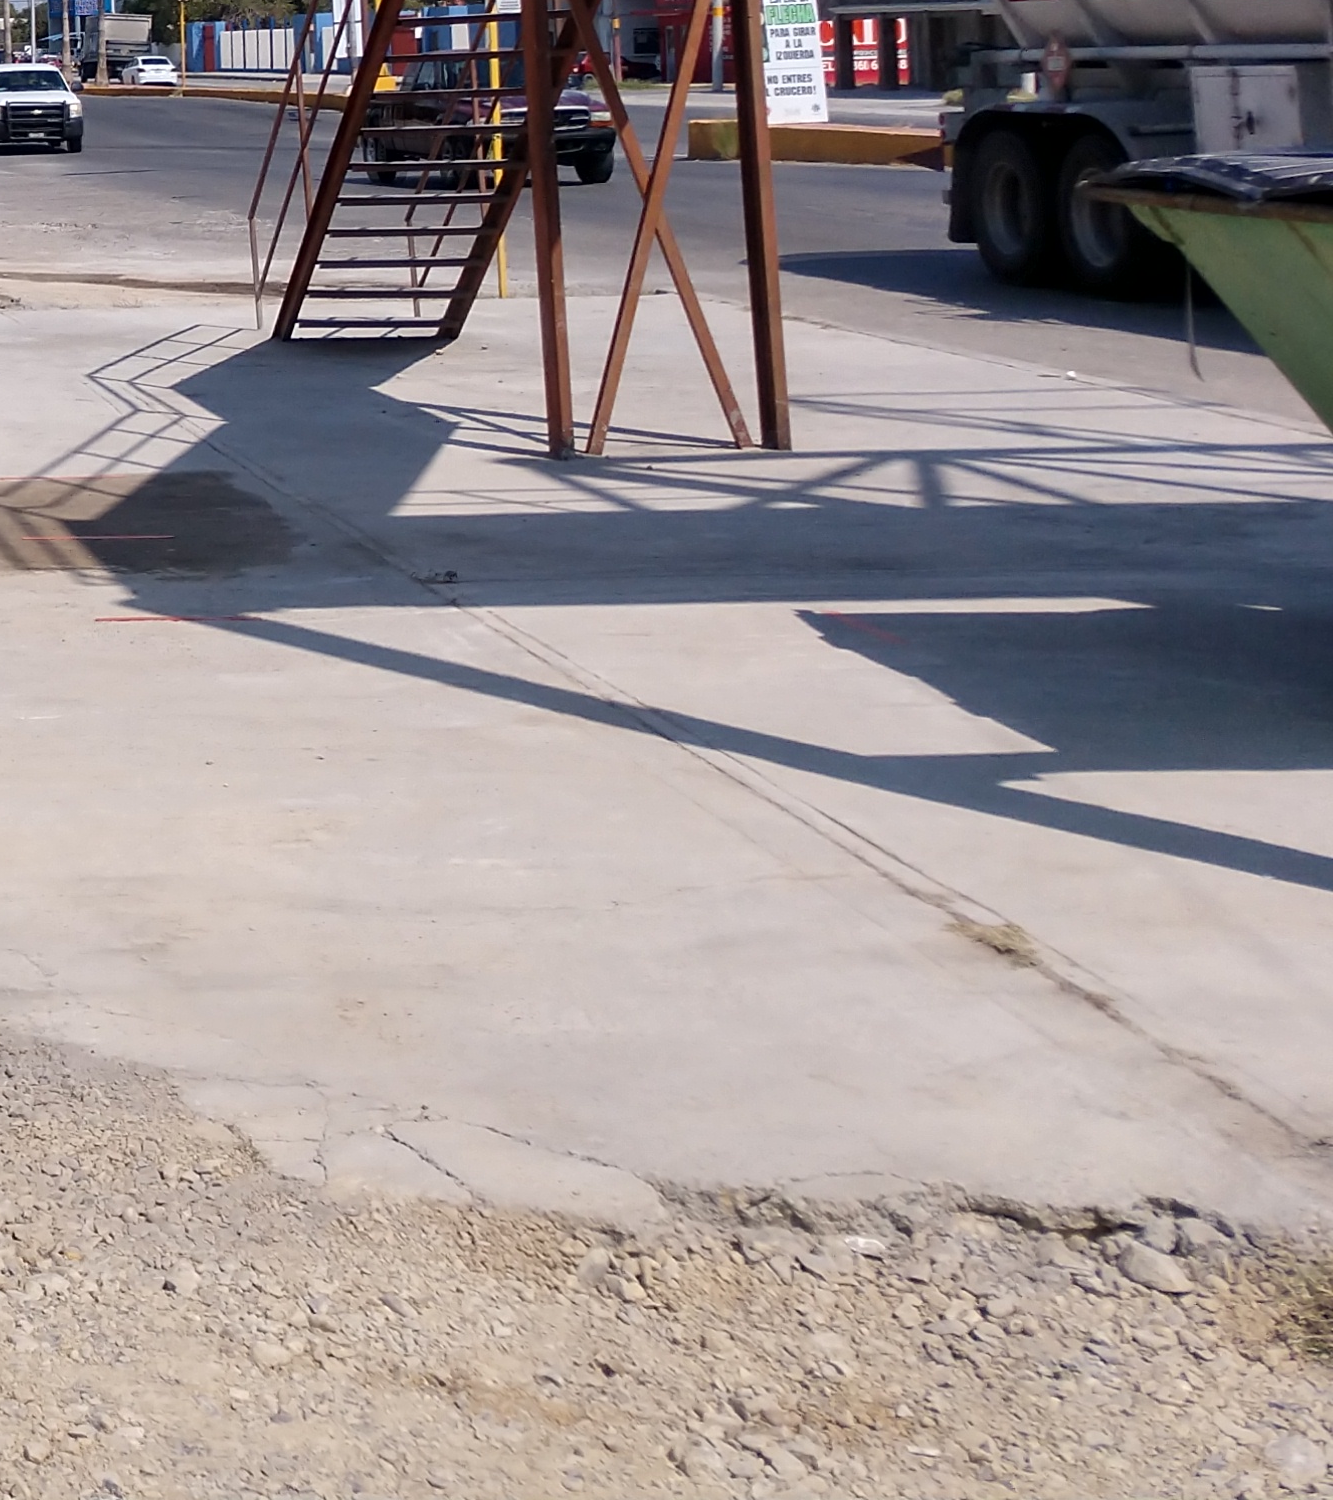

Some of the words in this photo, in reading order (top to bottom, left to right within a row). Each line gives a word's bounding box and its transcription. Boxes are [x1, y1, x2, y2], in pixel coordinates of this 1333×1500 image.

[765, 3, 816, 25] FLECHA
[770, 28, 790, 37] PARA
[793, 27, 816, 36] GIRAR
[793, 38, 803, 48] LA
[767, 75, 779, 84] NO
[782, 74, 812, 84] ENTRES
[774, 85, 816, 96] CRUCERO!
